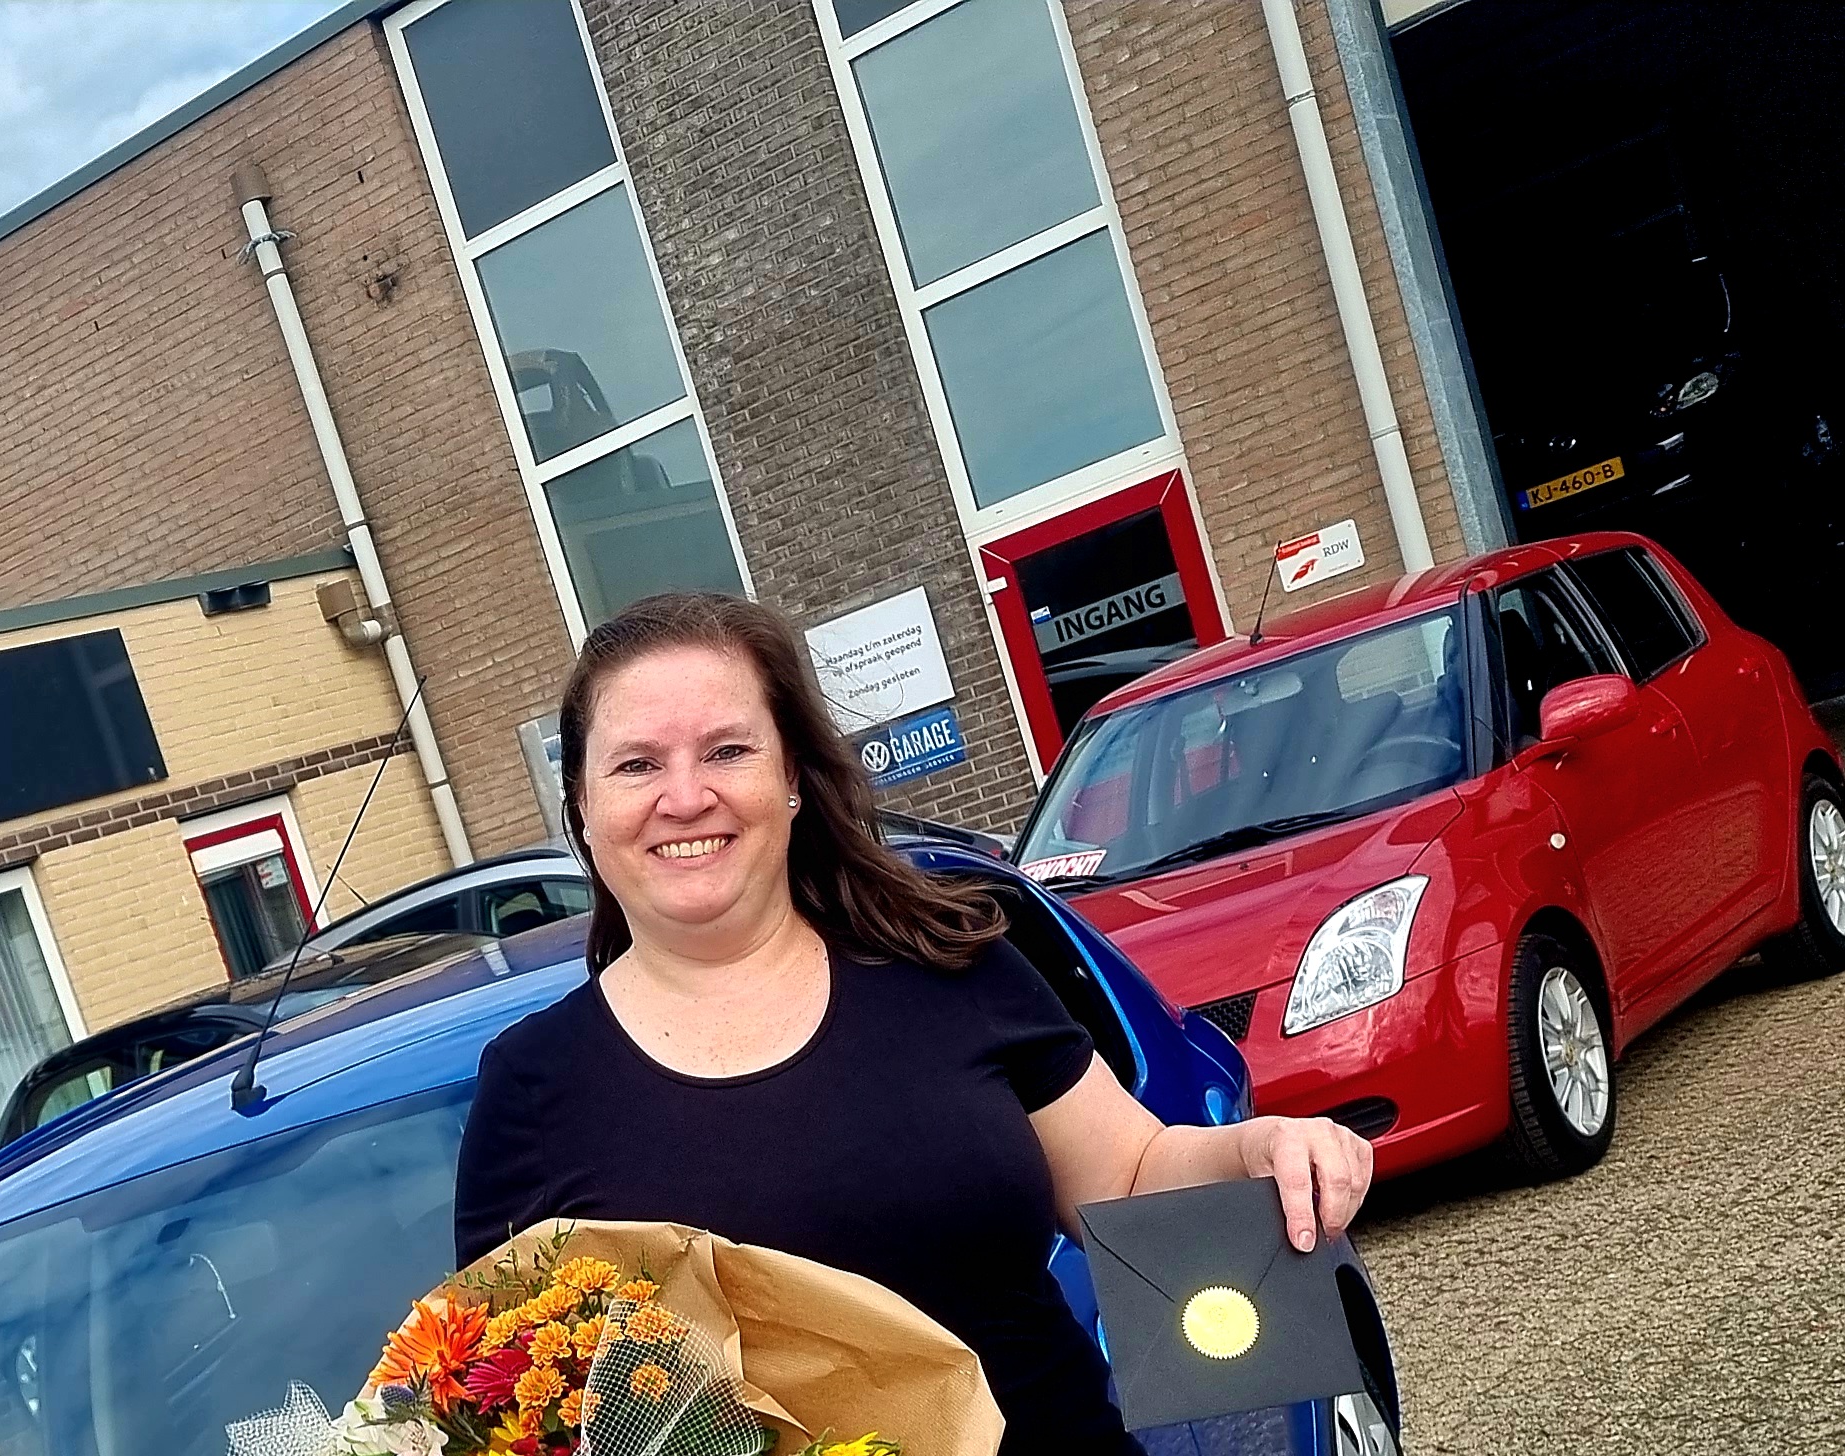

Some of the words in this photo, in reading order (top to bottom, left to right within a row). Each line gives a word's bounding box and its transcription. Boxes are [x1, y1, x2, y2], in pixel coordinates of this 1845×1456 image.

[1531, 463, 1615, 504] KJ-460-B
[1322, 539, 1350, 557] RDW
[1054, 583, 1167, 643] INGANG
[864, 640, 882, 653] t/m
[882, 625, 922, 646] zaterdag
[884, 638, 922, 661] geopend
[890, 719, 956, 763] GARAGE
